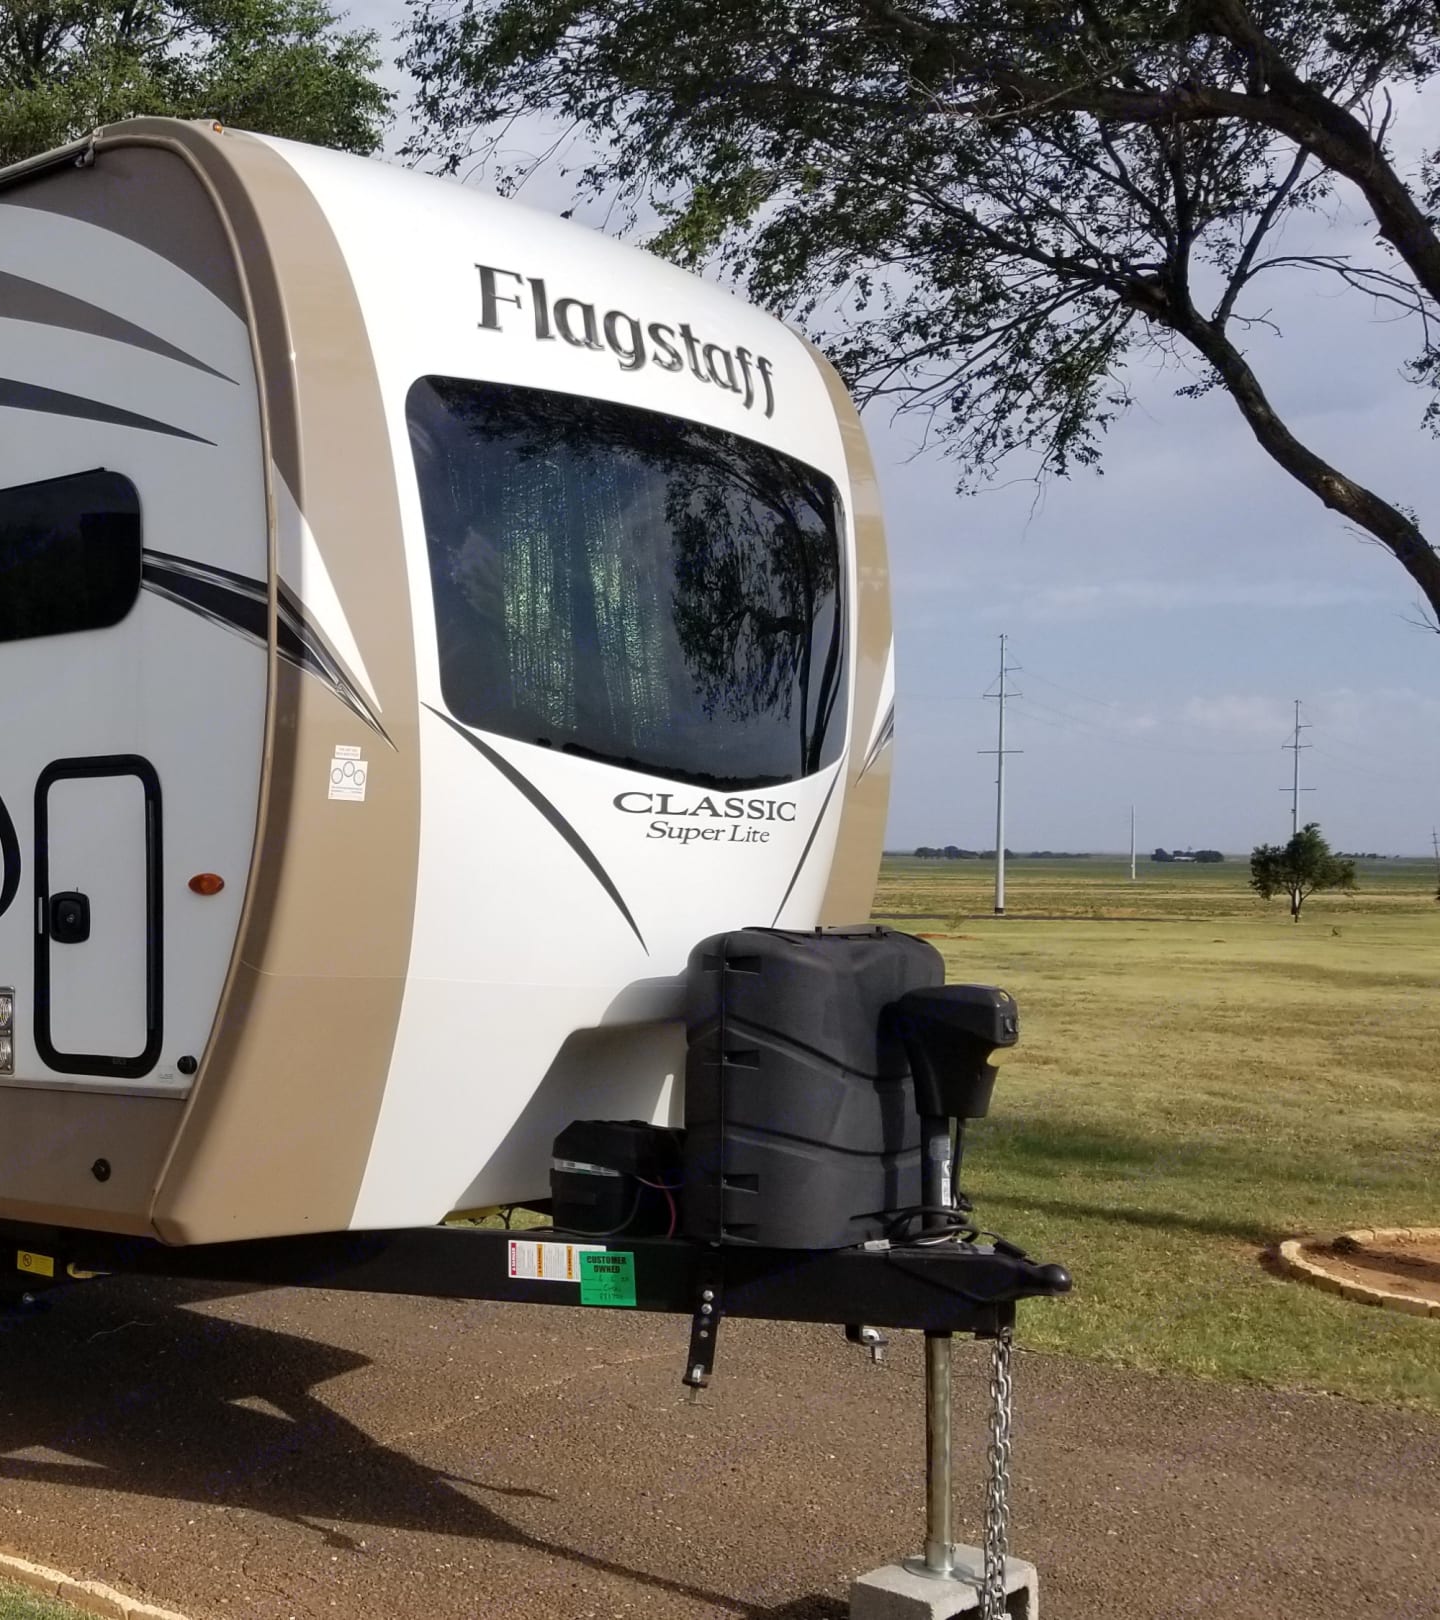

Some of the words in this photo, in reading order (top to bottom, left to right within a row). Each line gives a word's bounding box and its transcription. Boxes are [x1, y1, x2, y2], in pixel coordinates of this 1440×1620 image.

[474, 264, 776, 420] Flagstaff
[612, 791, 797, 822] CLASSIC
[646, 820, 726, 845] Super
[728, 824, 771, 844] Lite
[586, 1255, 627, 1265] CUSTOMER
[593, 1265, 621, 1274] OWNED
